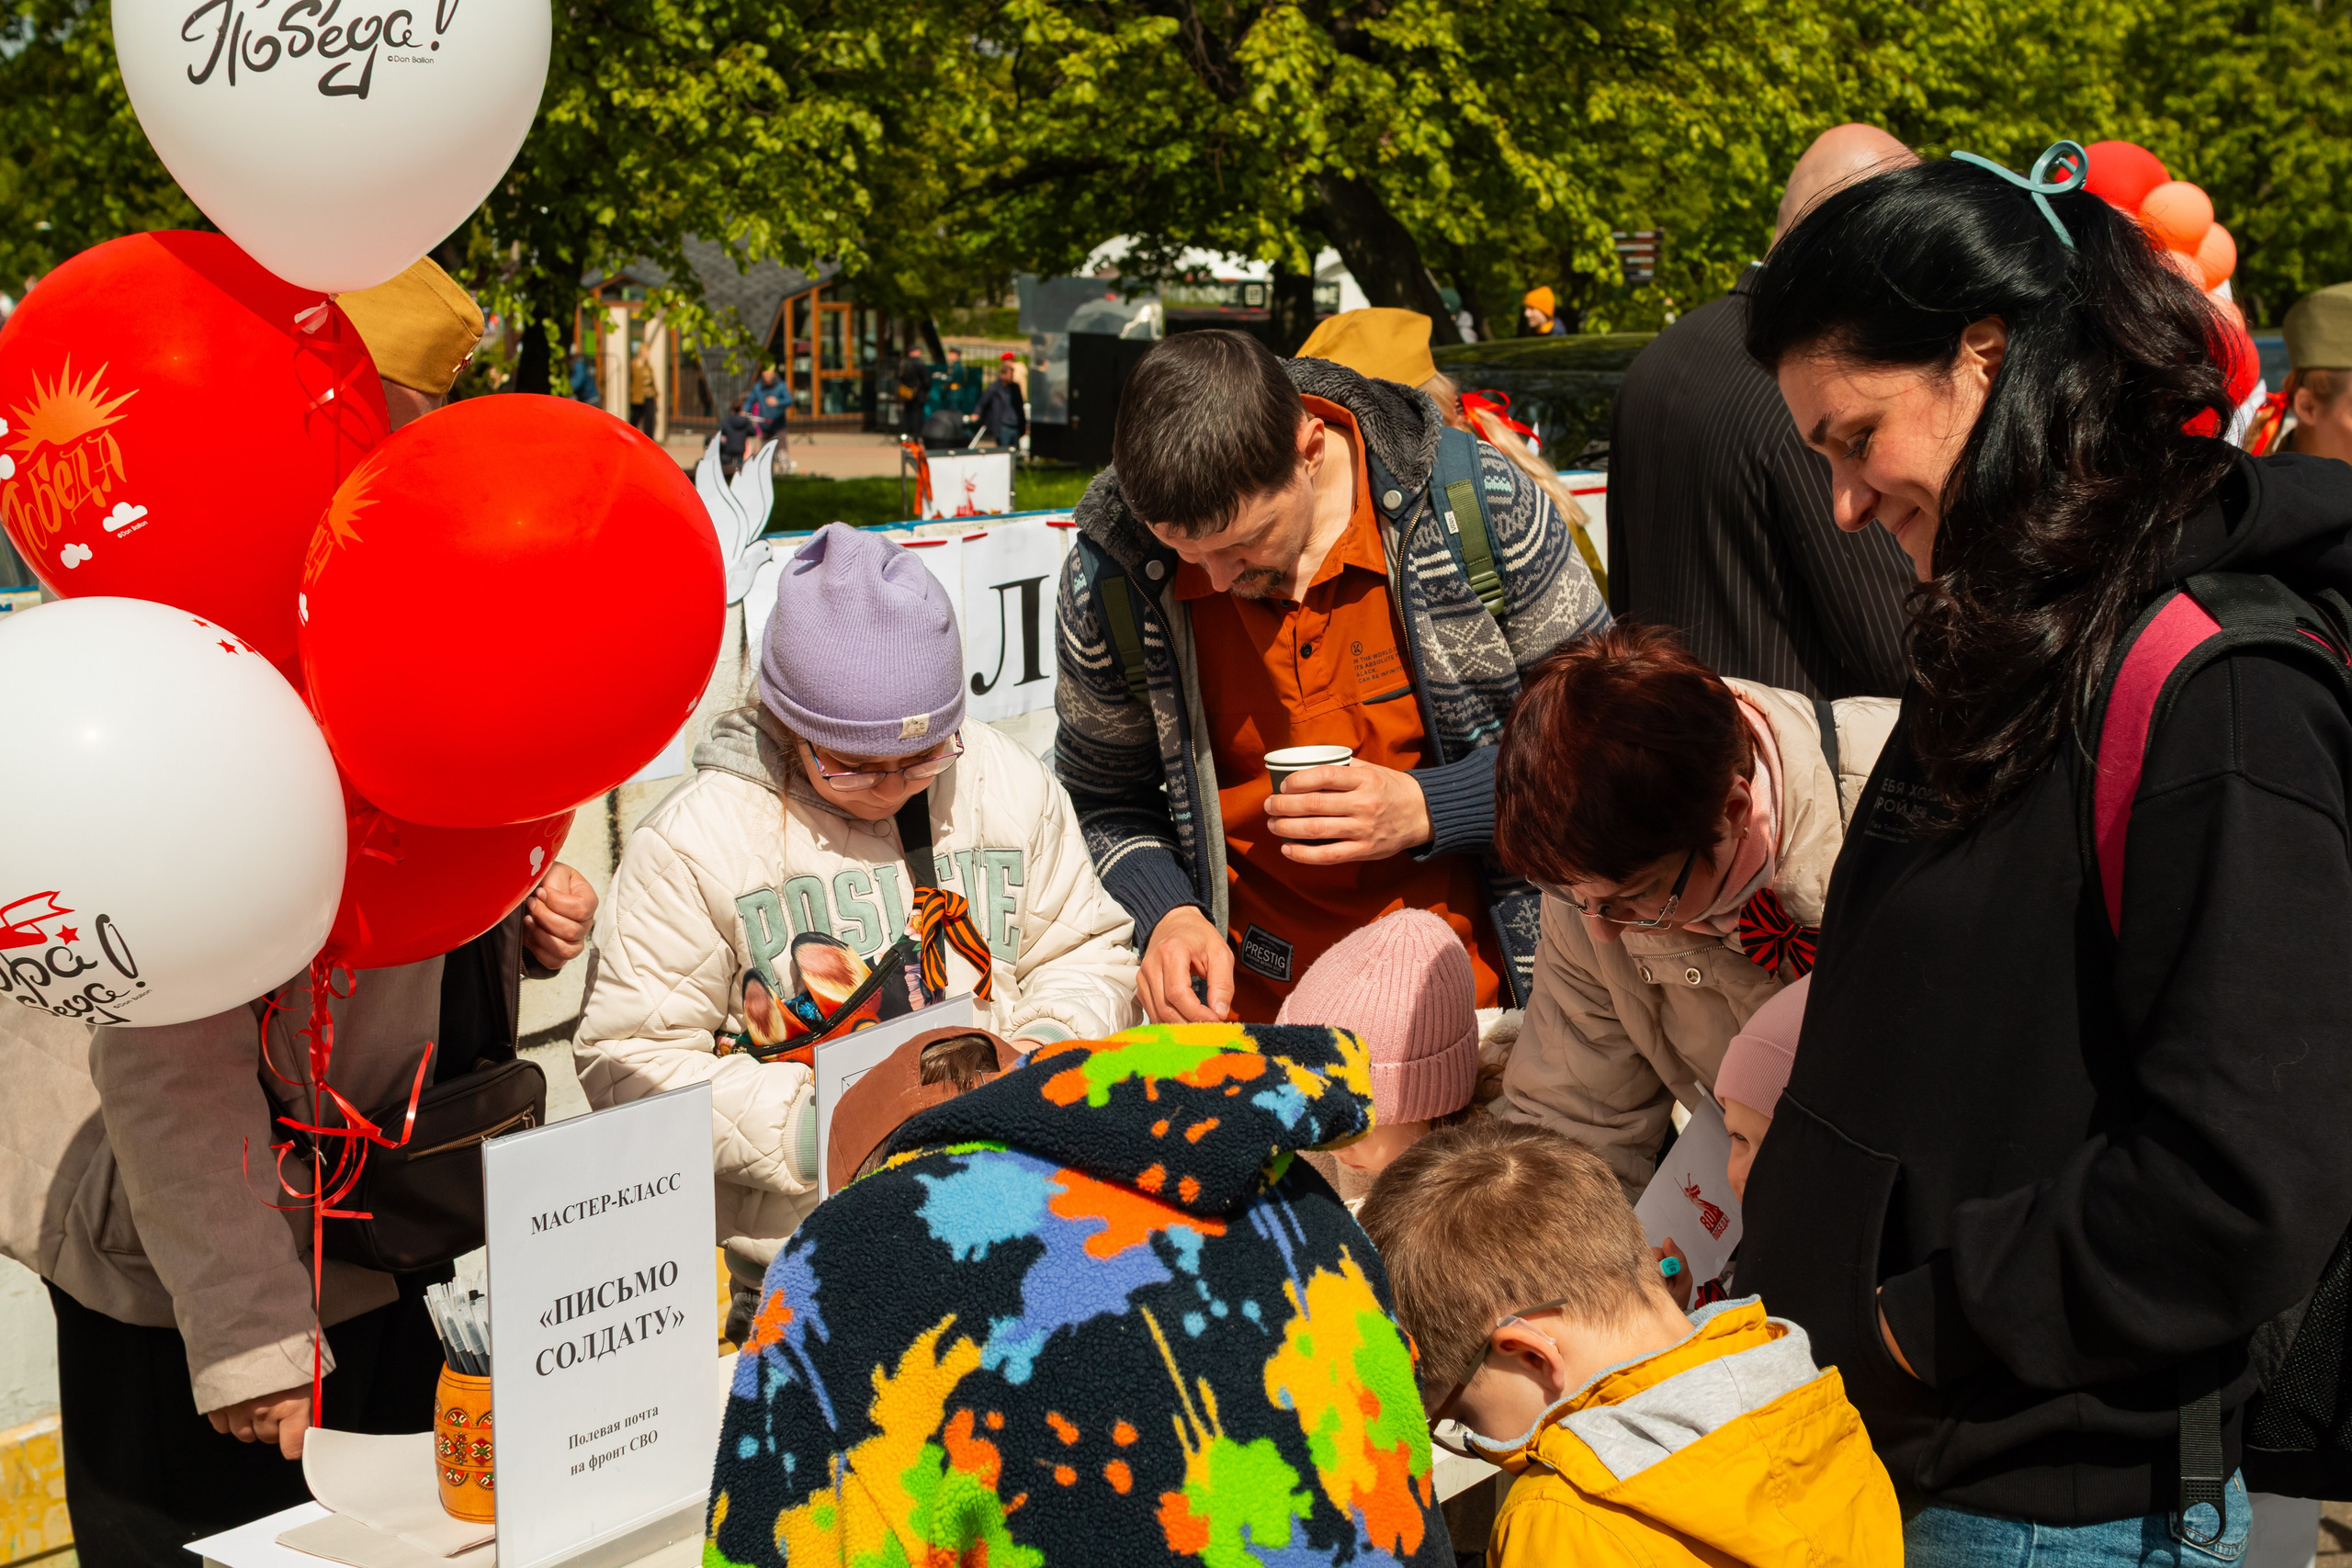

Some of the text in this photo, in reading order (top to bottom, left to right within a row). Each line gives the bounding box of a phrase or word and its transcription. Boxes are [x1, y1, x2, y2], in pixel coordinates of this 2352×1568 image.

[1364, 654, 1395, 669] ABSOLUTE
[1874, 795, 1907, 815] РОЙ
[1881, 777, 1905, 796] ЕБЯ
[1245, 941, 1286, 969] PRESTIG
[531, 1172, 682, 1235] МАСТЕР-КЛАСС
[539, 1260, 678, 1328] «ПИСЬМО
[536, 1305, 685, 1376] СОЛДАТУ»
[569, 1405, 659, 1450] Полевая почта
[571, 1429, 658, 1477] на фронт СВО
